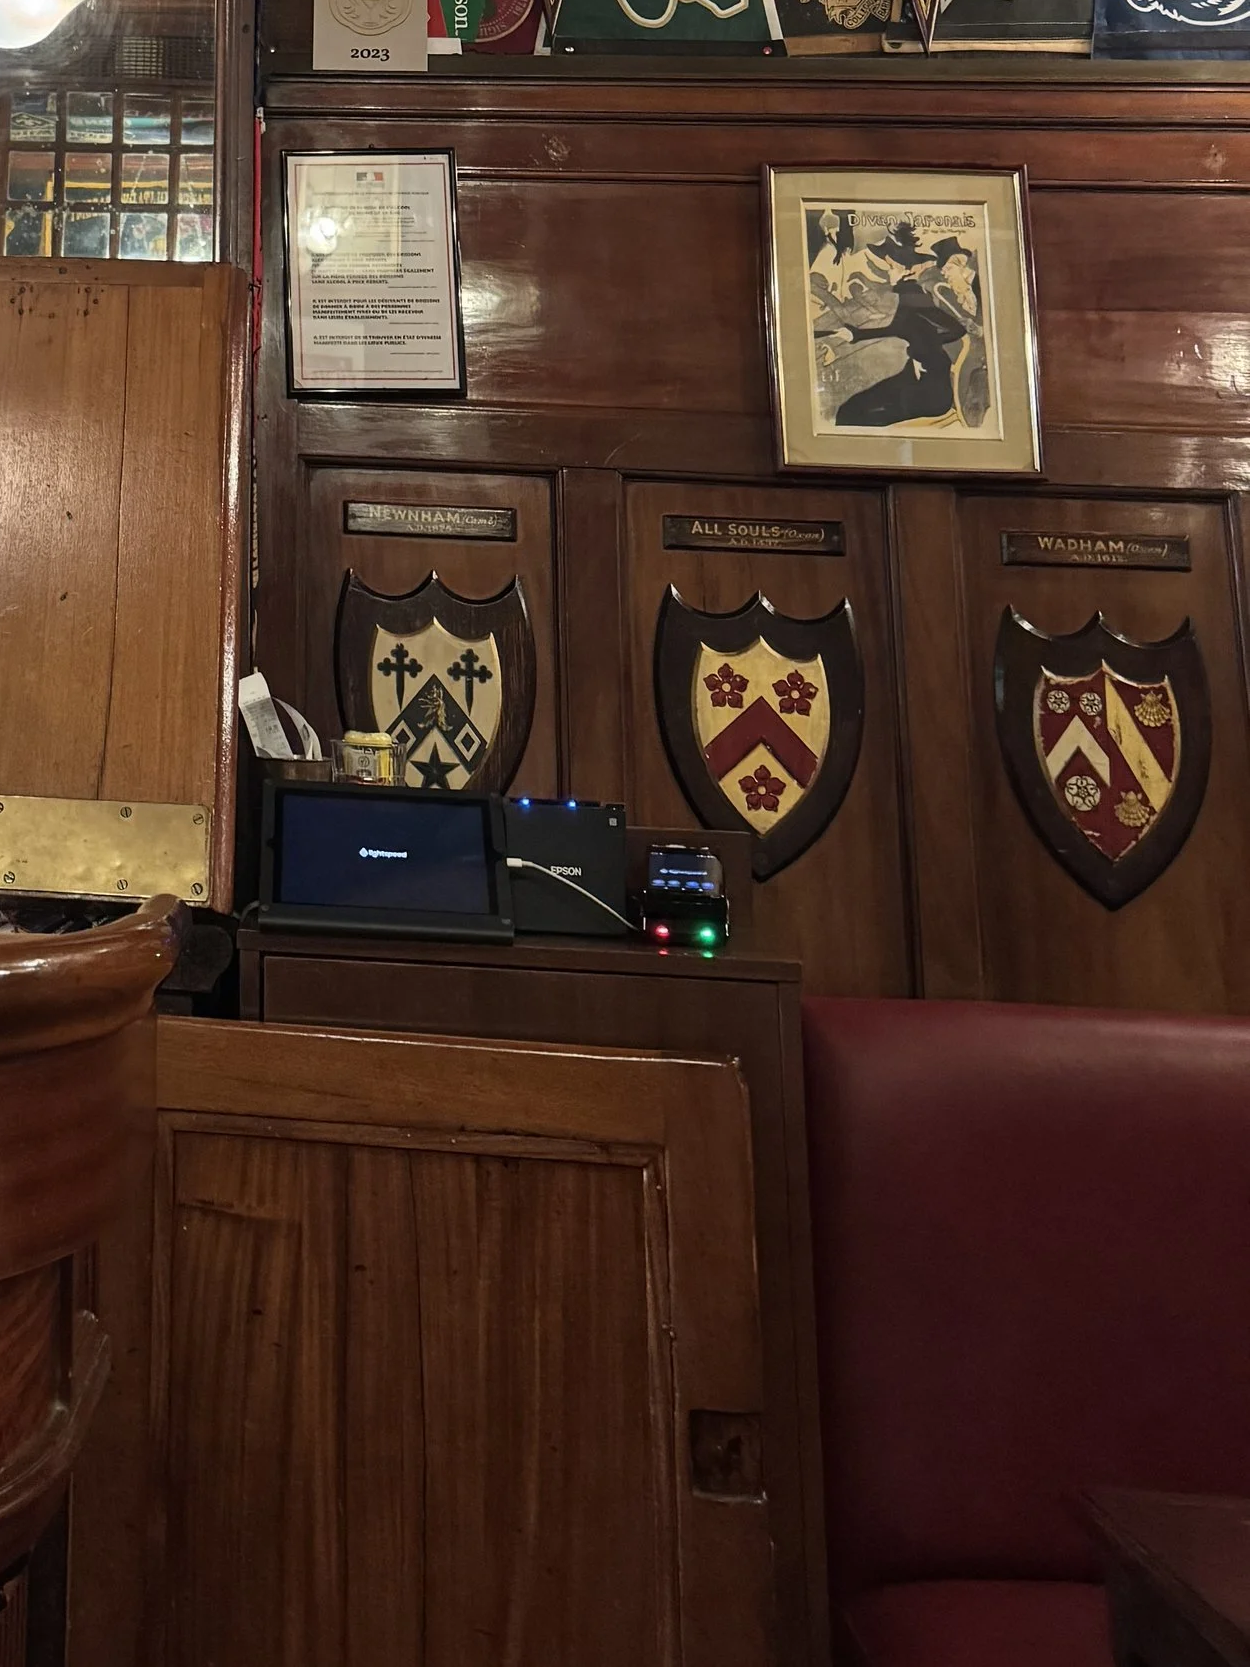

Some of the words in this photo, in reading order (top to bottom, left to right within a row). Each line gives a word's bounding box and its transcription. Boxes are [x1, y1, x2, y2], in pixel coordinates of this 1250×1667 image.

[350, 48, 391, 62] 2023
[369, 505, 461, 524] NEWNHAM
[691, 520, 723, 536] ALL
[727, 523, 781, 538] SOULS
[1037, 536, 1125, 554] WADHAM
[550, 865, 582, 877] EPSON
